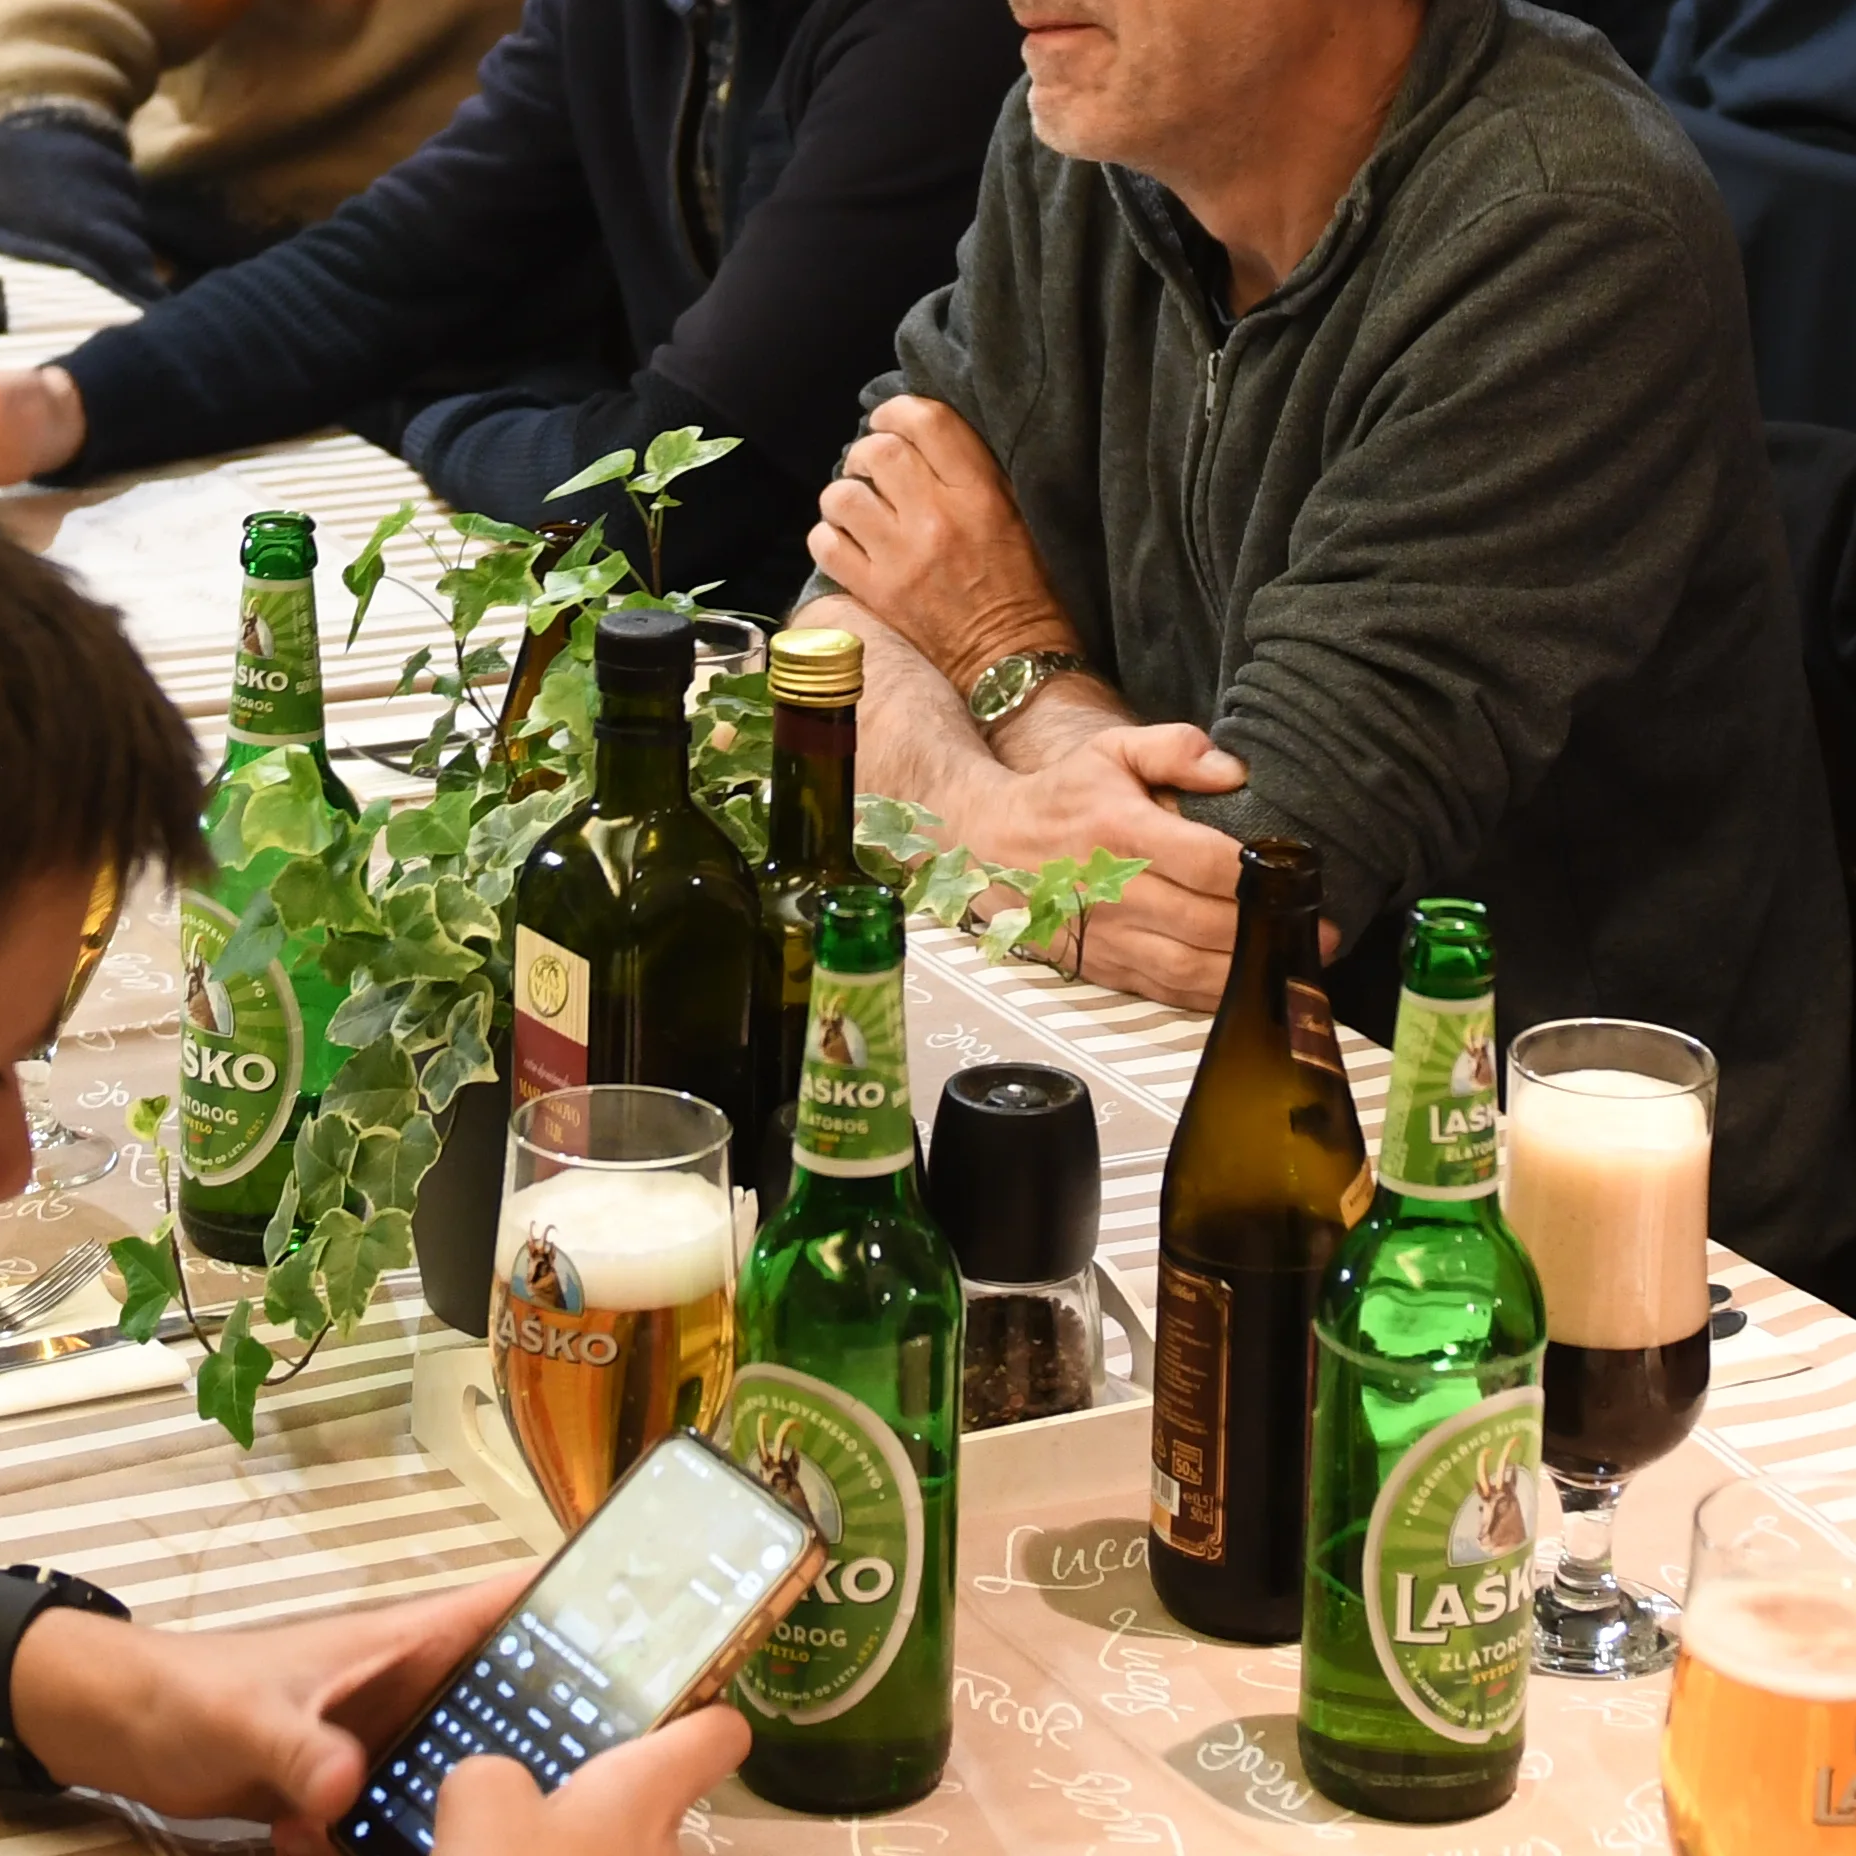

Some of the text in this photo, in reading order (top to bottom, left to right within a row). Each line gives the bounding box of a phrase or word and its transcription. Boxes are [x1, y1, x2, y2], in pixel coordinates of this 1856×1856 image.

[236, 660, 289, 692] ŠKO
[182, 912, 229, 947] SLOVEN
[182, 1030, 277, 1092] ŠKO
[799, 1070, 886, 1109] AŠKO
[181, 1093, 239, 1126] ATOROG
[183, 1114, 213, 1135] VETLO
[771, 1395, 858, 1453] SLOVENSKO
[857, 1451, 883, 1490] PIVO
[1407, 1430, 1492, 1516] LEGENDARNO
[1393, 1557, 1535, 1644] LAŠK
[775, 1620, 848, 1649] OROG
[1438, 1629, 1532, 1673] ZLATORO
[814, 1685, 831, 1698] OD
[832, 1665, 858, 1689] LETA
